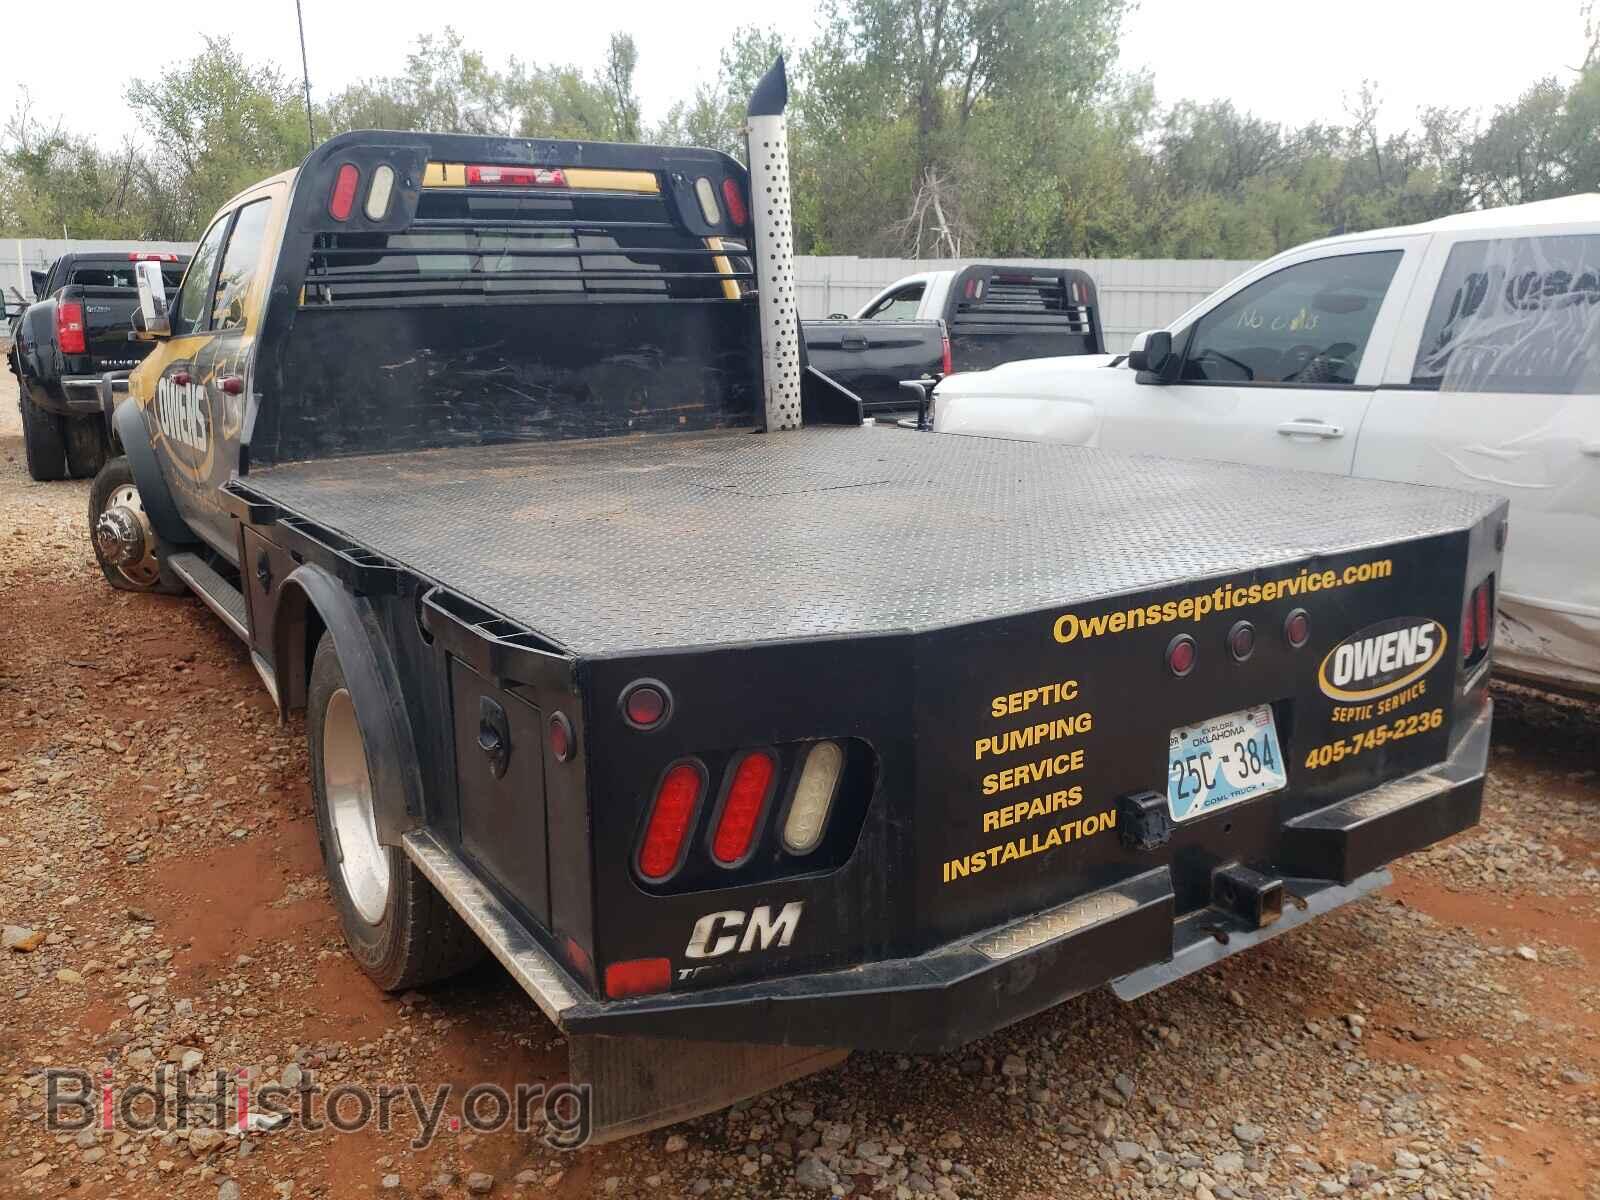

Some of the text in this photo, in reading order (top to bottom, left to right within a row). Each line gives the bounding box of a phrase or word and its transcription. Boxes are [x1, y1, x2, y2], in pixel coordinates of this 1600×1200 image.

[158, 376, 207, 452] OWENS
[1053, 559, 1392, 644] Owenssepticservice.com
[1333, 622, 1435, 687] OWENS
[991, 680, 1078, 718] SEPTIC
[1331, 679, 1426, 722] SEPTIC SERVICE
[975, 712, 1092, 760] PUMPING
[1192, 726, 1246, 748] OKLAHOMA
[1202, 721, 1233, 735] EXPLORE
[1304, 708, 1443, 770] 405-745-2236
[982, 749, 1084, 795] SERVICE
[1231, 785, 1257, 796] TRUCK
[983, 786, 1082, 833] REPAIRS
[943, 809, 1117, 883] INSTALLATION
[684, 901, 804, 959] CM
